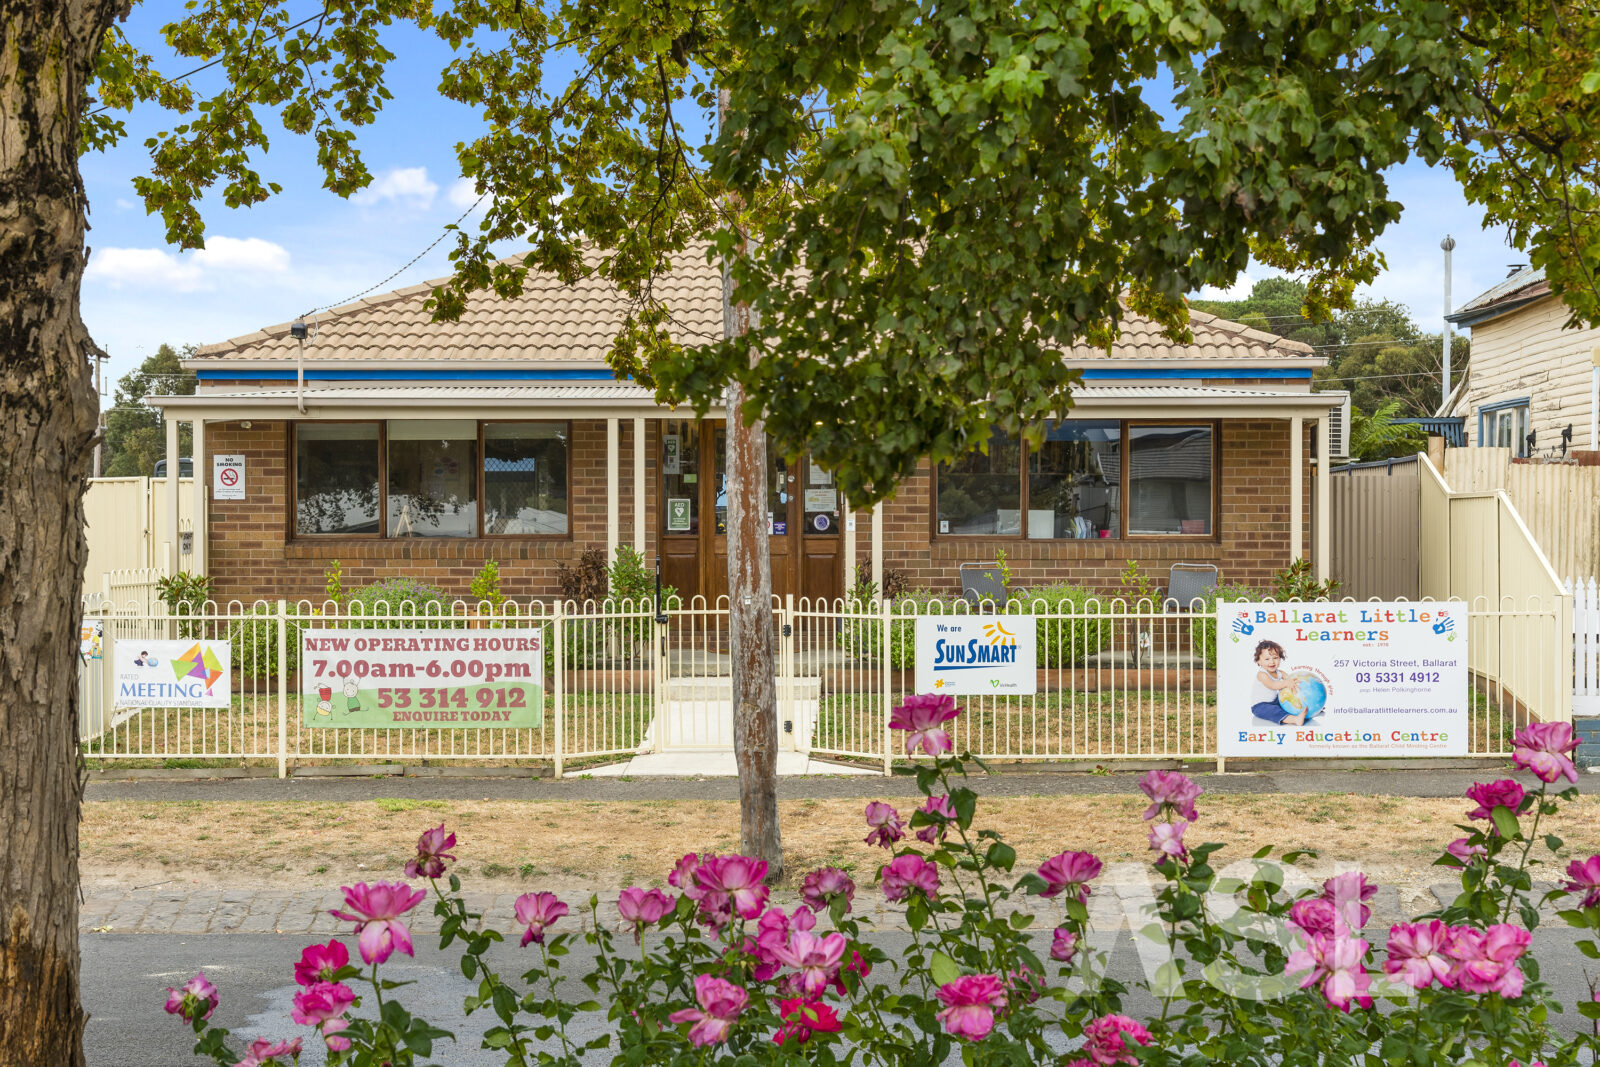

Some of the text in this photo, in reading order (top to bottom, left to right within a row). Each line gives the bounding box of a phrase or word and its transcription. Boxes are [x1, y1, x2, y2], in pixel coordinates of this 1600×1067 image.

[1255, 608, 1431, 623] Ballarat Little
[937, 624, 948, 632] We
[1296, 629, 1389, 641] Learners
[305, 637, 540, 652] NEW OPERATING HOURS
[312, 659, 532, 682] 7.00am-6.00pm
[1352, 659, 1387, 667] Victoria
[1390, 659, 1420, 668] Street,
[1422, 659, 1457, 667] Ballarat
[1356, 672, 1440, 683] 03 5331 4912
[120, 682, 202, 698] MEETING
[378, 688, 527, 708] 53 314 912
[392, 711, 512, 722] ENQUIRE TODAY
[1238, 730, 1449, 745] Early Education Centre
